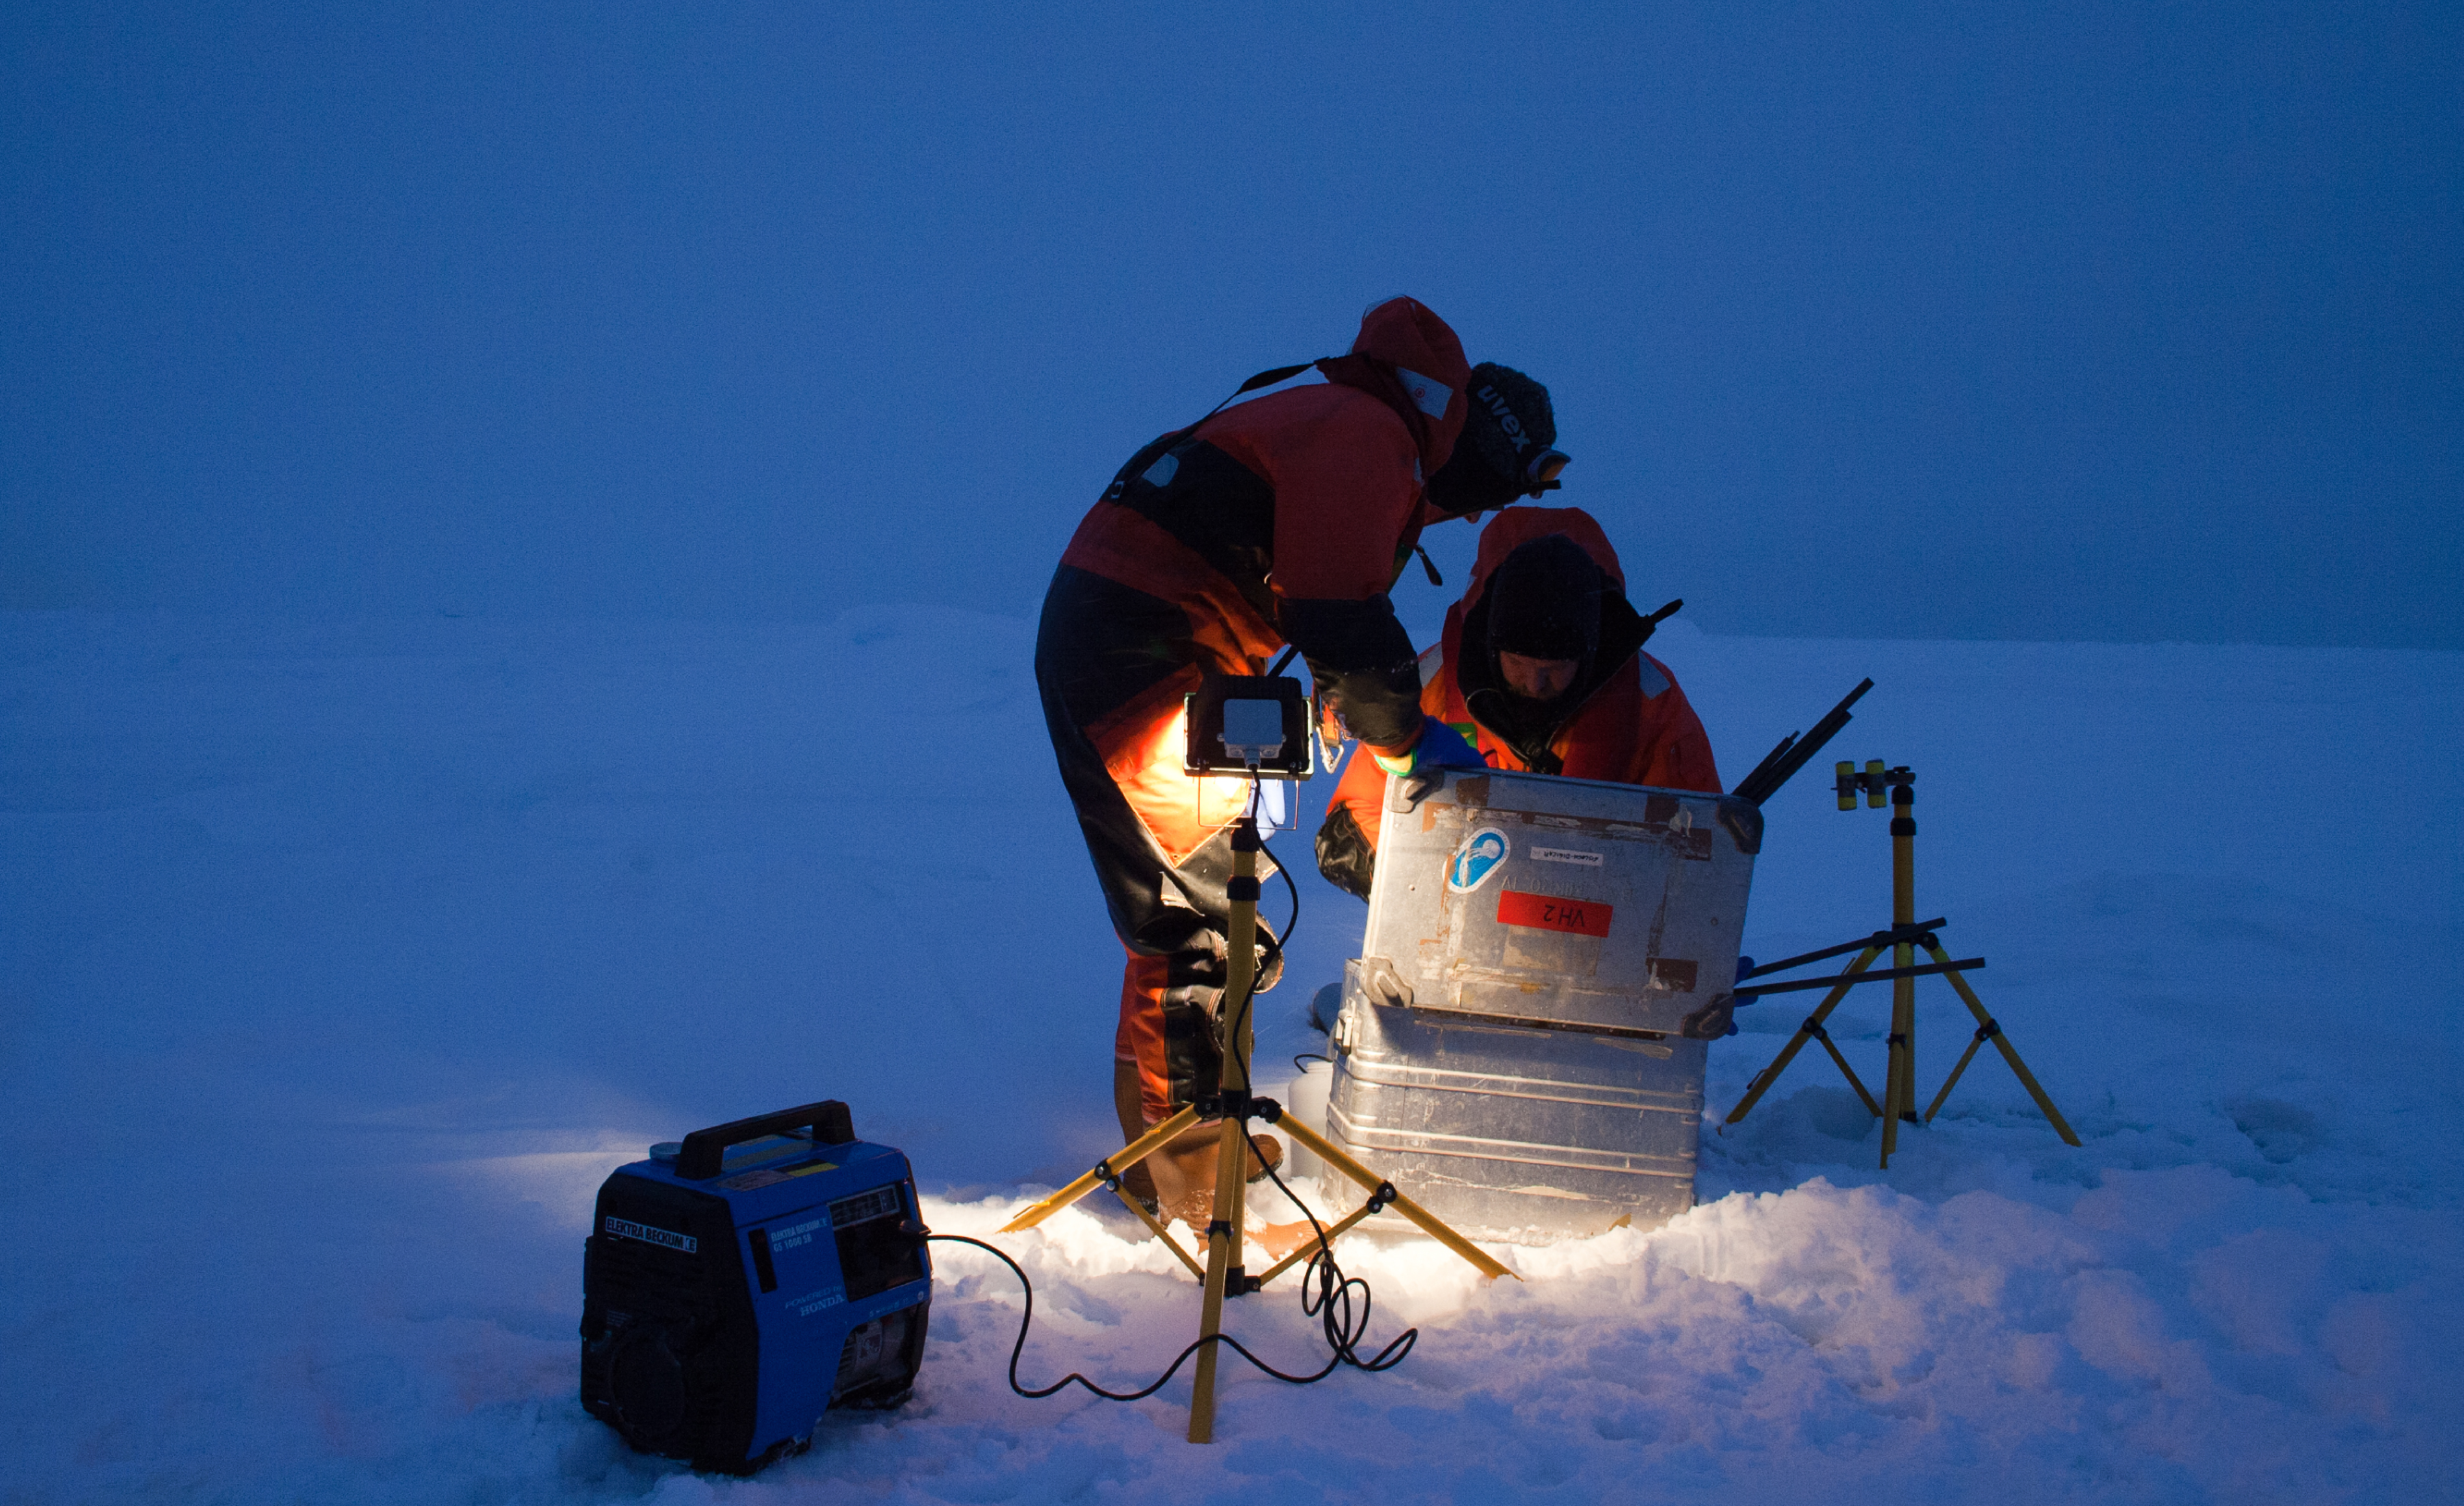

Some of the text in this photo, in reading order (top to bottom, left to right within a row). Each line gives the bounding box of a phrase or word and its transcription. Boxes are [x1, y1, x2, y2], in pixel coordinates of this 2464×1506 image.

[1477, 385, 1531, 454] uvex
[606, 1218, 643, 1238] ELEKTRA
[645, 1227, 683, 1249] BECKUM
[771, 1227, 796, 1242] ELEKTRA
[795, 1220, 819, 1234] BECKUM
[784, 1236, 802, 1249] 1000
[800, 1294, 845, 1317] HONDA
